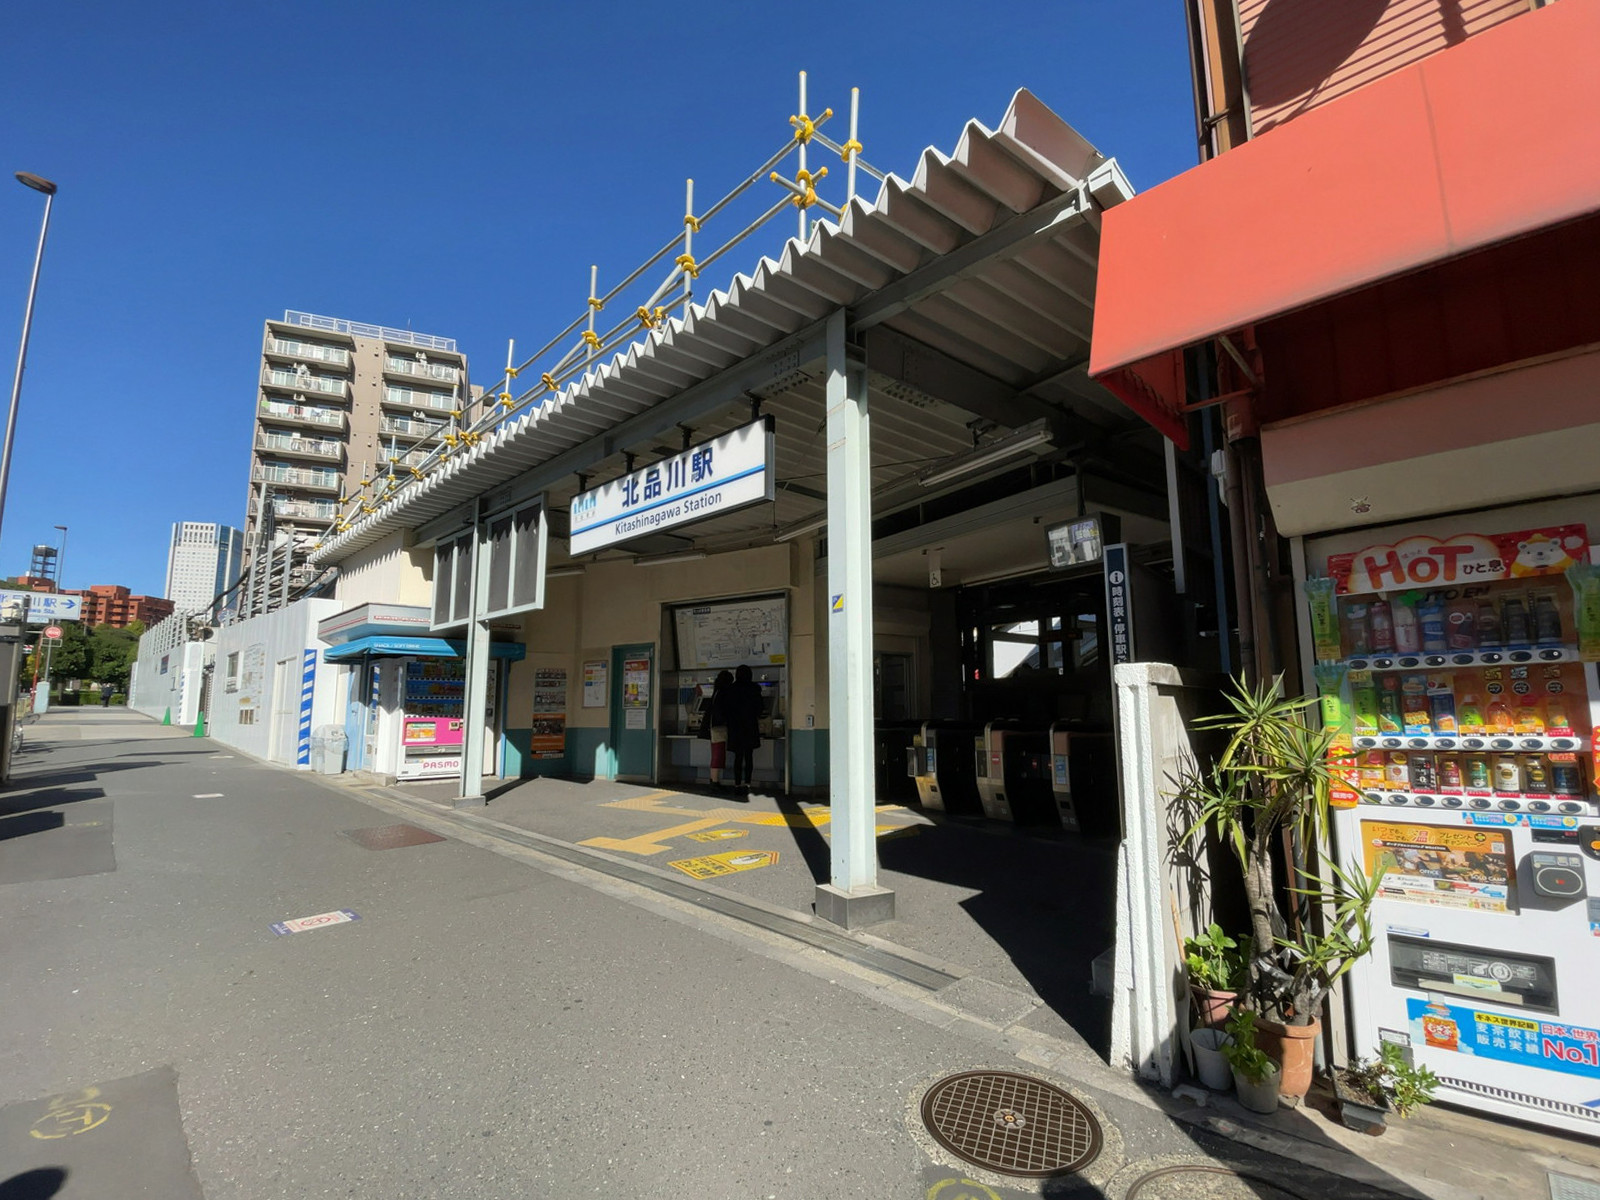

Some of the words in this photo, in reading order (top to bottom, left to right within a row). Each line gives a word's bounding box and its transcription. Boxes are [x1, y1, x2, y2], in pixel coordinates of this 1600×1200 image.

[622, 446, 714, 508] 北品川駅
[615, 505, 681, 535] Kitashinagawa
[684, 492, 722, 514] Station
[423, 761, 459, 769] PASMO
[1440, 832, 1473, 840] プレゼント
[1444, 839, 1485, 847] キャンペーン
[1420, 868, 1440, 876] OFFICE
[1476, 1013, 1536, 1030] ギネス世界記録
[1476, 1022, 1539, 1043] 麦茶飲料
[1543, 1039, 1599, 1066] No.1
